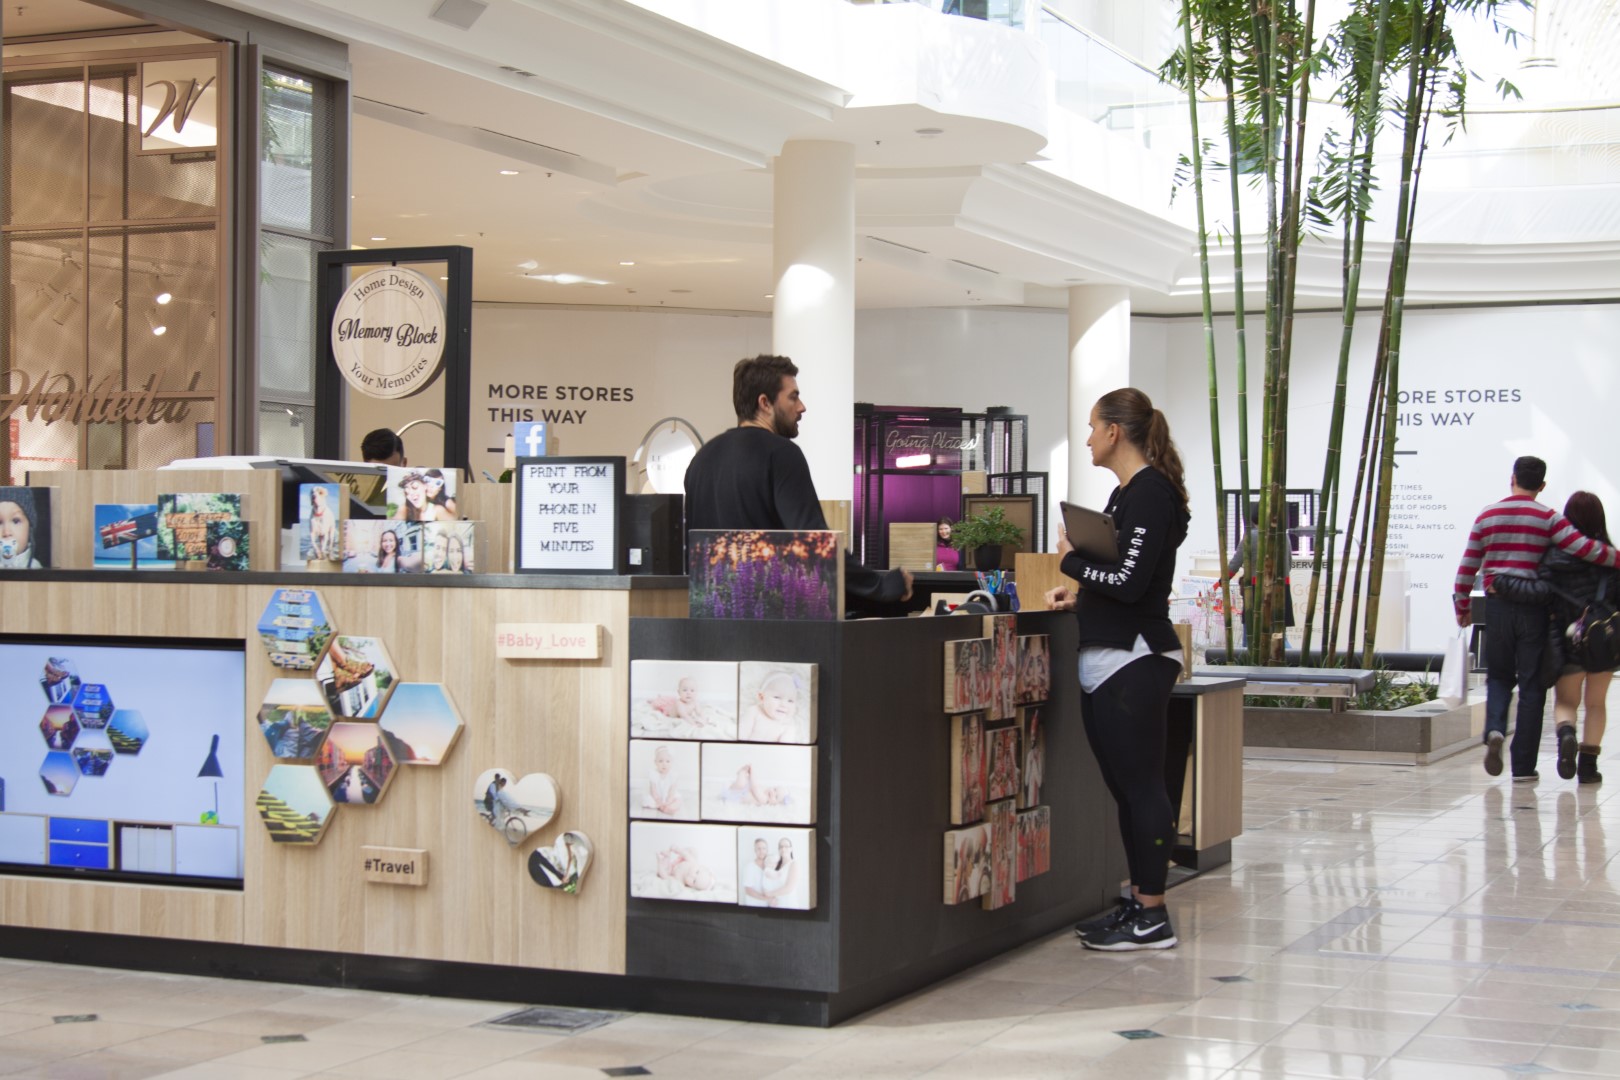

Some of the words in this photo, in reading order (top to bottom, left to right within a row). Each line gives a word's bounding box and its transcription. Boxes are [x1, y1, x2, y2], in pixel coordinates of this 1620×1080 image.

[145, 76, 216, 138] W
[353, 278, 386, 301] Home
[389, 274, 425, 299] Design
[338, 318, 393, 343] Memory
[396, 323, 438, 347] Block
[350, 362, 374, 386] Your
[375, 357, 428, 389] Memories
[488, 384, 548, 399] MORE
[555, 386, 634, 402] STORES
[1384, 390, 1436, 404] ORE
[1445, 389, 1522, 403] STORES
[488, 408, 533, 422] THIS
[542, 409, 587, 424] WAY
[1431, 412, 1475, 426] WAY
[886, 430, 929, 454] Going
[930, 431, 980, 451] Places
[530, 466, 566, 477] PRINT
[574, 466, 607, 477] FROM
[548, 483, 579, 494] YOUR
[539, 504, 578, 514] PHONE
[582, 504, 596, 514] IN
[553, 522, 579, 533] FIVE
[540, 540, 594, 552] MINUTES
[1291, 561, 1329, 569] SERVE
[498, 633, 587, 650] #Baby_Love
[364, 858, 414, 874] #Travel
